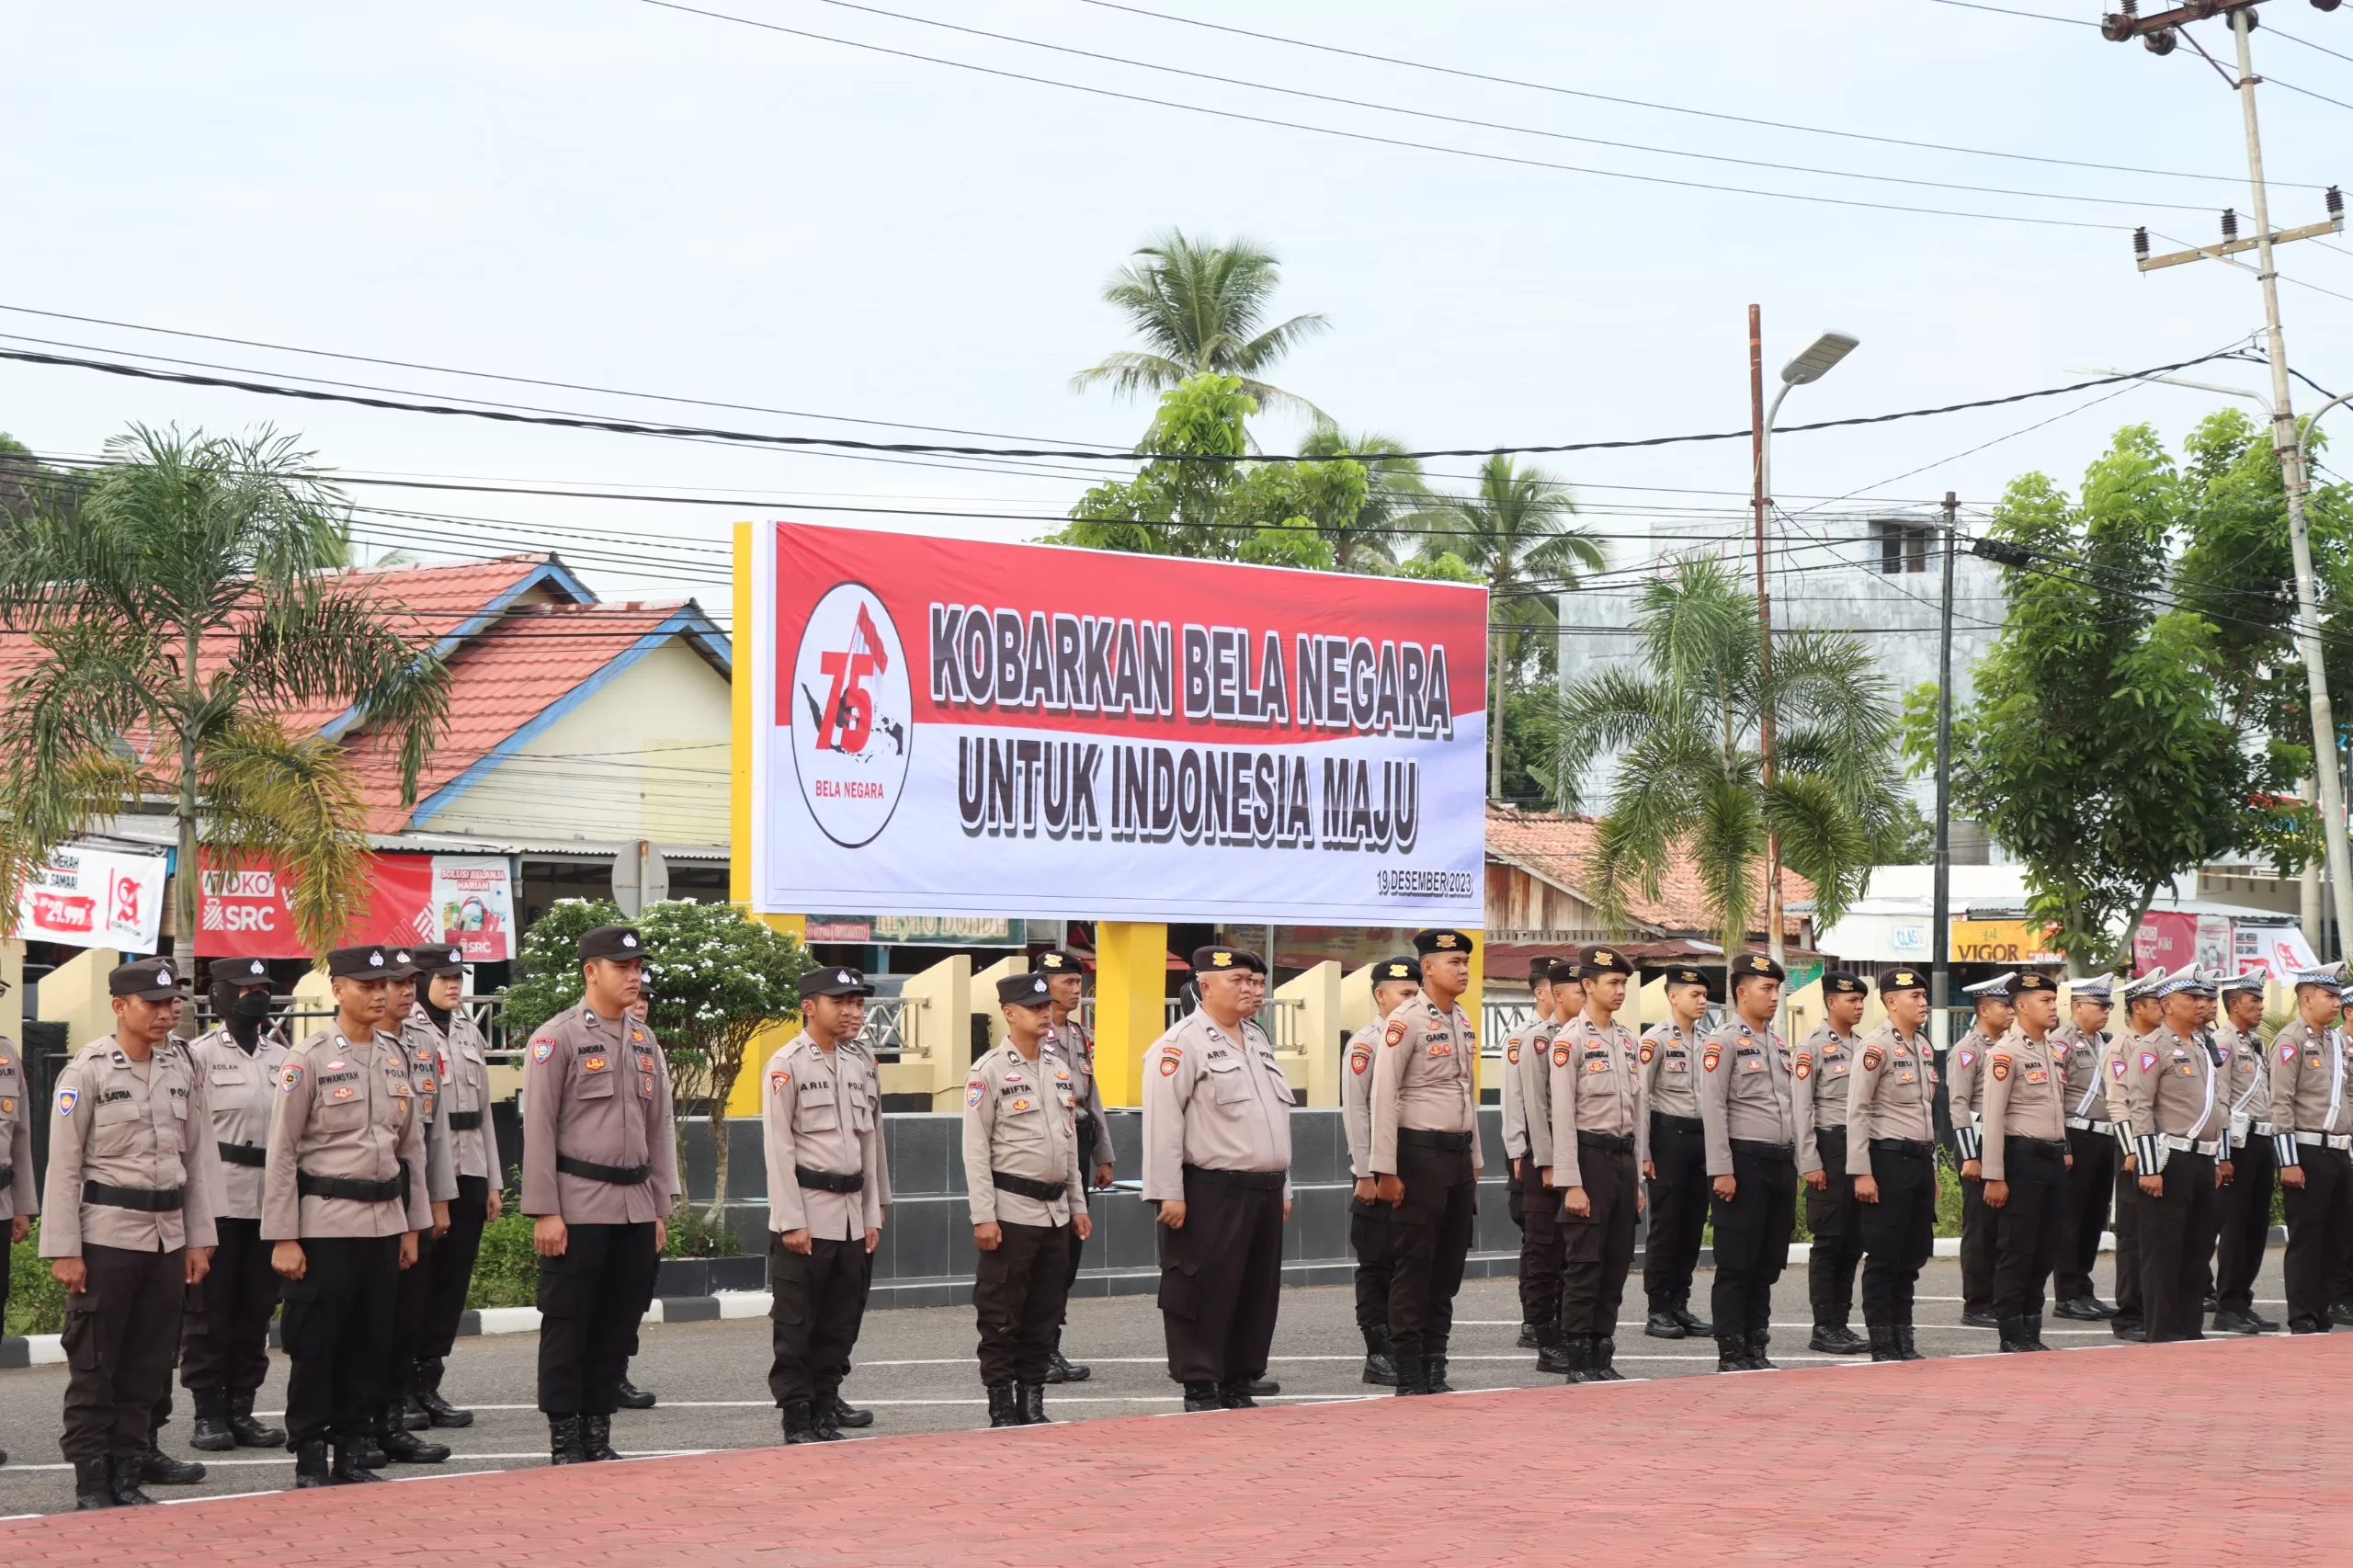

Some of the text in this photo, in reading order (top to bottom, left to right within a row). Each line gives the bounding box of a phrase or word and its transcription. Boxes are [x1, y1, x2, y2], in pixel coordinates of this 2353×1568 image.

[929, 602, 1451, 734] KOBARKAN BELA NEGARA
[815, 651, 874, 753] 75
[815, 779, 884, 799] BELA NEGARA
[958, 736, 1418, 847] UNTUK INDONESIA MAJU
[441, 869, 506, 881] SOLUSI BELANJA
[457, 881, 489, 891] HARIAN
[1377, 869, 1472, 897] 19 DESEMBER 2023
[225, 906, 274, 931] SRC
[469, 941, 492, 953] SRC
[2158, 937, 2173, 950] Kiki
[1958, 944, 2020, 962] VIGOR
[1426, 1032, 1449, 1042] GANDI
[1207, 1051, 1228, 1060] ARIE
[2024, 1062, 2042, 1070] NATA
[318, 1071, 359, 1086] IRWANSYAH
[800, 1081, 829, 1092] ARIE
[1002, 1084, 1031, 1096] MIFTA
